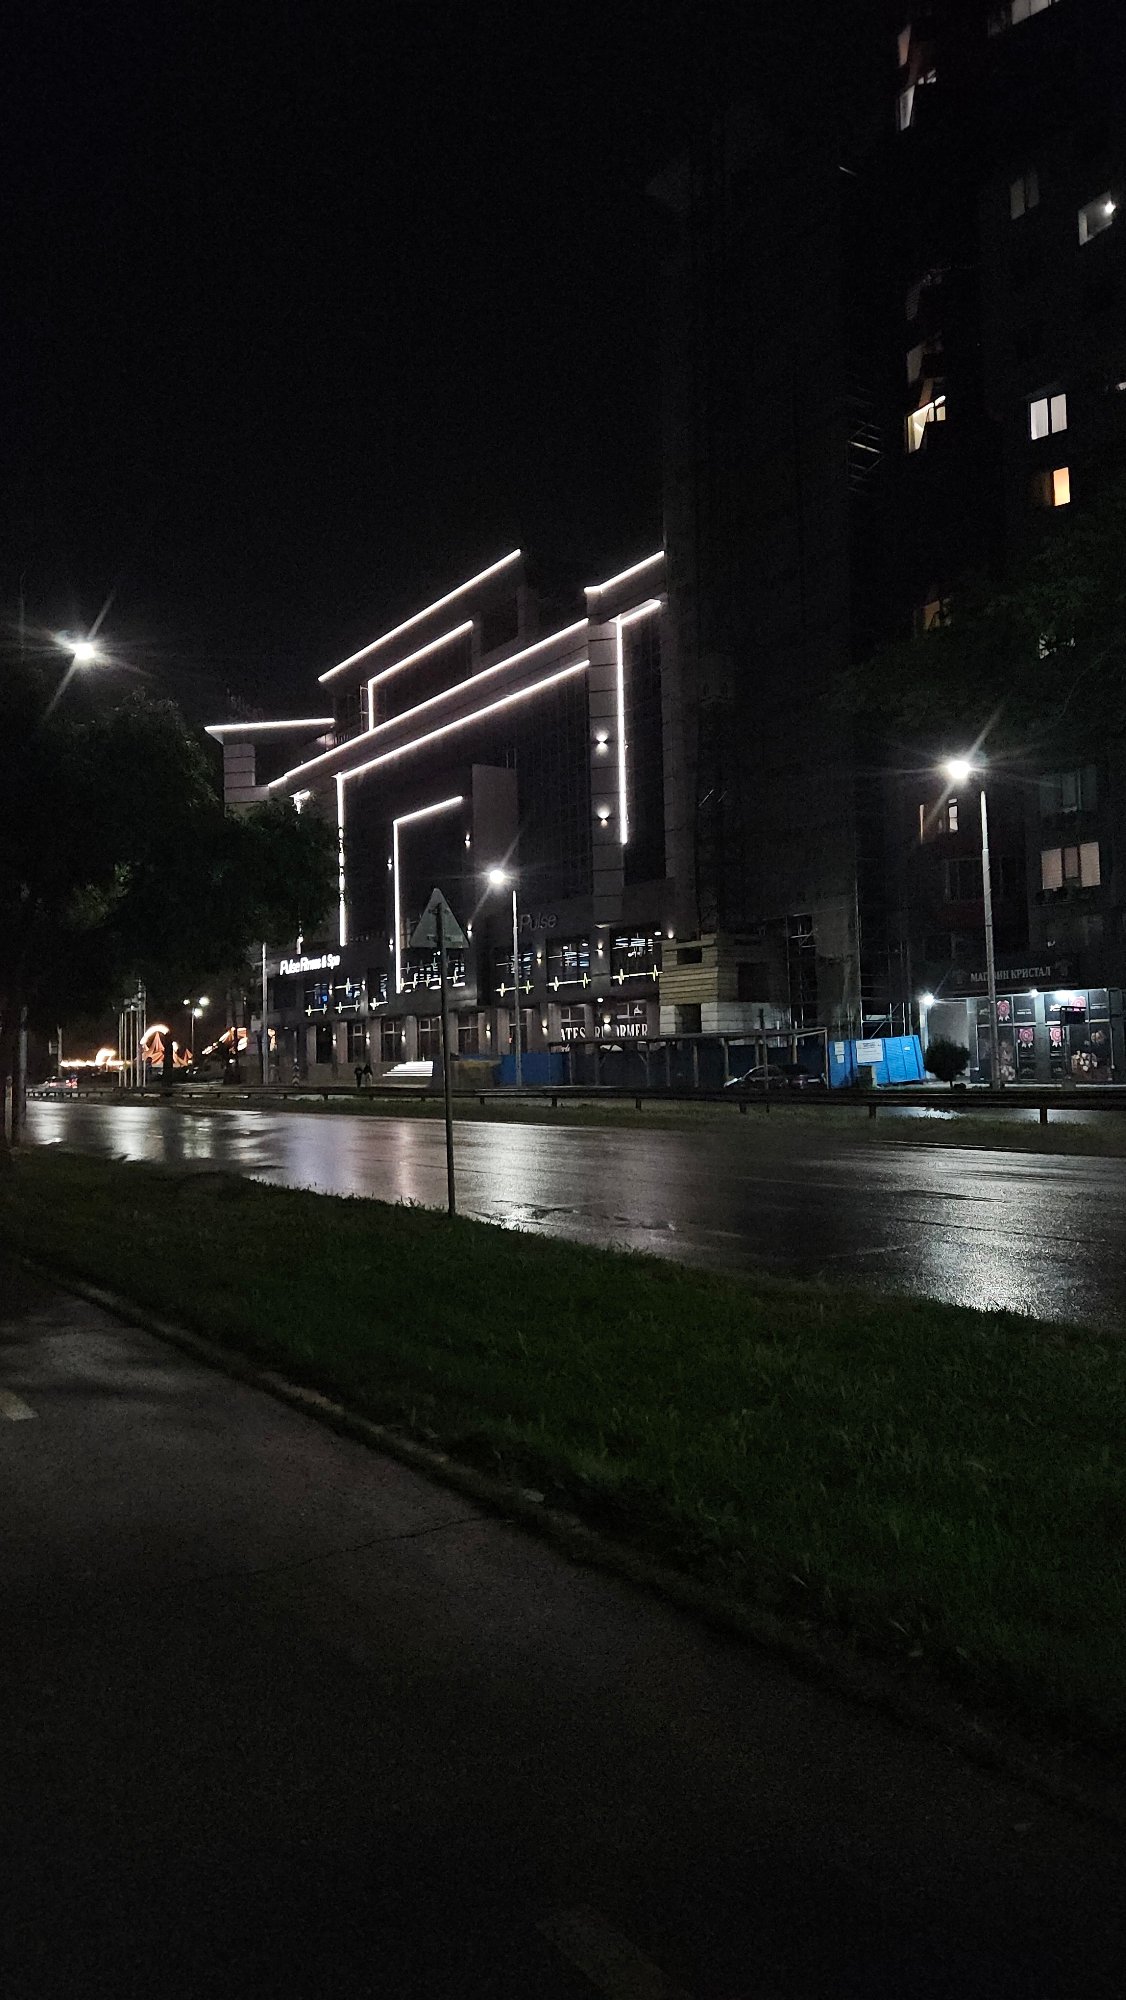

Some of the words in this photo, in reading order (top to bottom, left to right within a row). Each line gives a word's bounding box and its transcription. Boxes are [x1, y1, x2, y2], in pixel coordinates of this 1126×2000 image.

[520, 912, 557, 932] Pulse
[280, 959, 300, 975] Pulse
[1011, 967, 1051, 979] КРИСТАЛ
